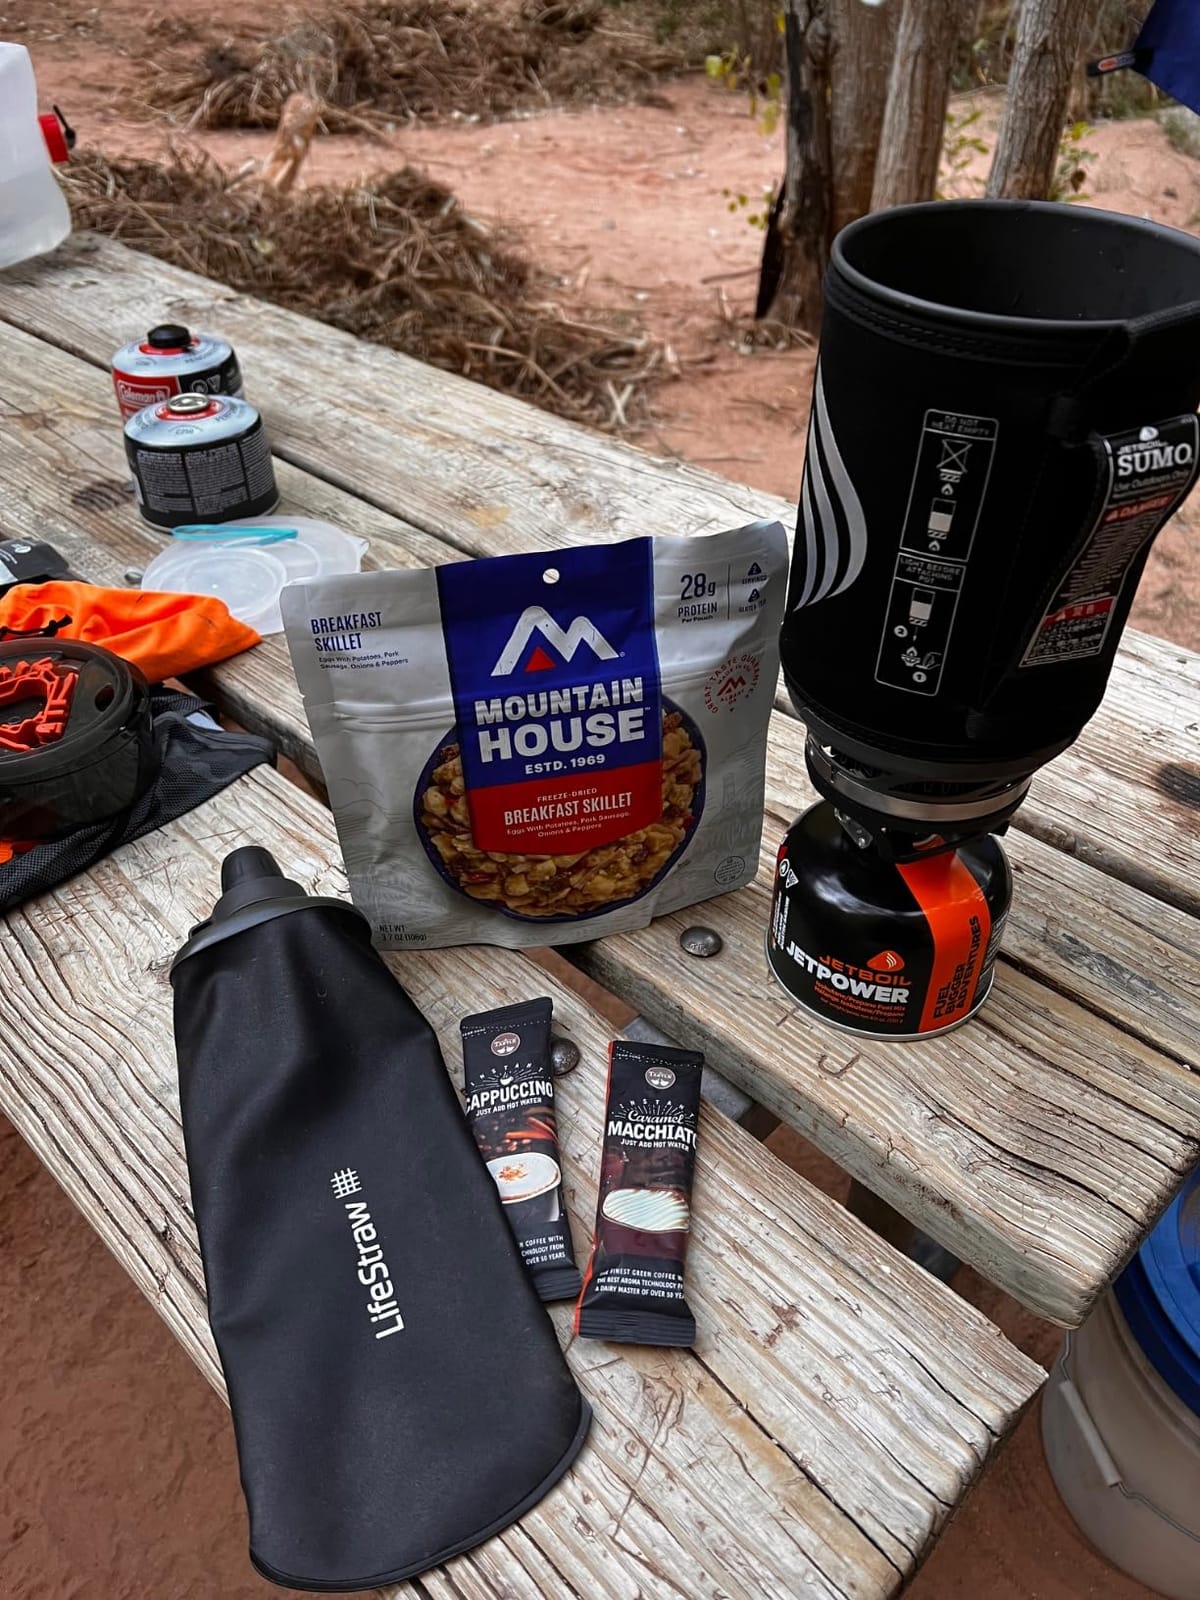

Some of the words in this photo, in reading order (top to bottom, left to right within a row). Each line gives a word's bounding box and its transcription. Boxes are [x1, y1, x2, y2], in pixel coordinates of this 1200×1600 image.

[1118, 443, 1192, 476] SUMO
[680, 572, 716, 602] 28g
[678, 602, 718, 618] PROTEIN
[311, 611, 382, 634] BREAKFAST
[314, 633, 362, 652] SKILLET
[475, 677, 644, 726] MOUNTAIN
[478, 708, 645, 763] HOUSE
[525, 761, 567, 775] ESTD.
[570, 753, 606, 768] 1969
[537, 787, 598, 803] FREEZE-DRIED
[504, 800, 580, 826] BREAKFAST
[582, 792, 633, 814] SKILLET
[786, 941, 910, 1004] JETPOWER
[819, 955, 912, 986] JETBOIL
[956, 914, 982, 1009] ADVENTURES
[933, 982, 952, 1018] FUEL
[945, 963, 966, 1015] BIGGER
[470, 1062, 544, 1087] INSTANT
[476, 1107, 492, 1117] JUST
[493, 1103, 506, 1113] ADD
[507, 1101, 519, 1110] HOT
[520, 1097, 542, 1107] WATER
[619, 1098, 695, 1118] INSTANT
[628, 1109, 684, 1124] Caramel
[620, 1138, 638, 1147] JUST
[638, 1139, 652, 1148] ADD
[653, 1140, 666, 1149] HOT
[667, 1140, 690, 1153] WATER
[525, 1236, 547, 1247] COFFEE
[548, 1234, 564, 1243] WITH
[550, 1242, 566, 1252] FROM
[549, 1251, 567, 1261] YEARS
[345, 1202, 405, 1340] LifeStraw
[609, 1267, 631, 1276] FINEST
[631, 1268, 652, 1278] GREEN
[653, 1271, 676, 1281] COFFEE
[600, 1285, 617, 1293] DAIRY
[618, 1285, 641, 1296] MASTER
[641, 1288, 650, 1296] OF
[651, 1289, 666, 1298] OVER
[606, 1275, 620, 1284] BEST
[620, 1276, 641, 1286] AROMA
[642, 1279, 677, 1290] TECHNOLOGY
